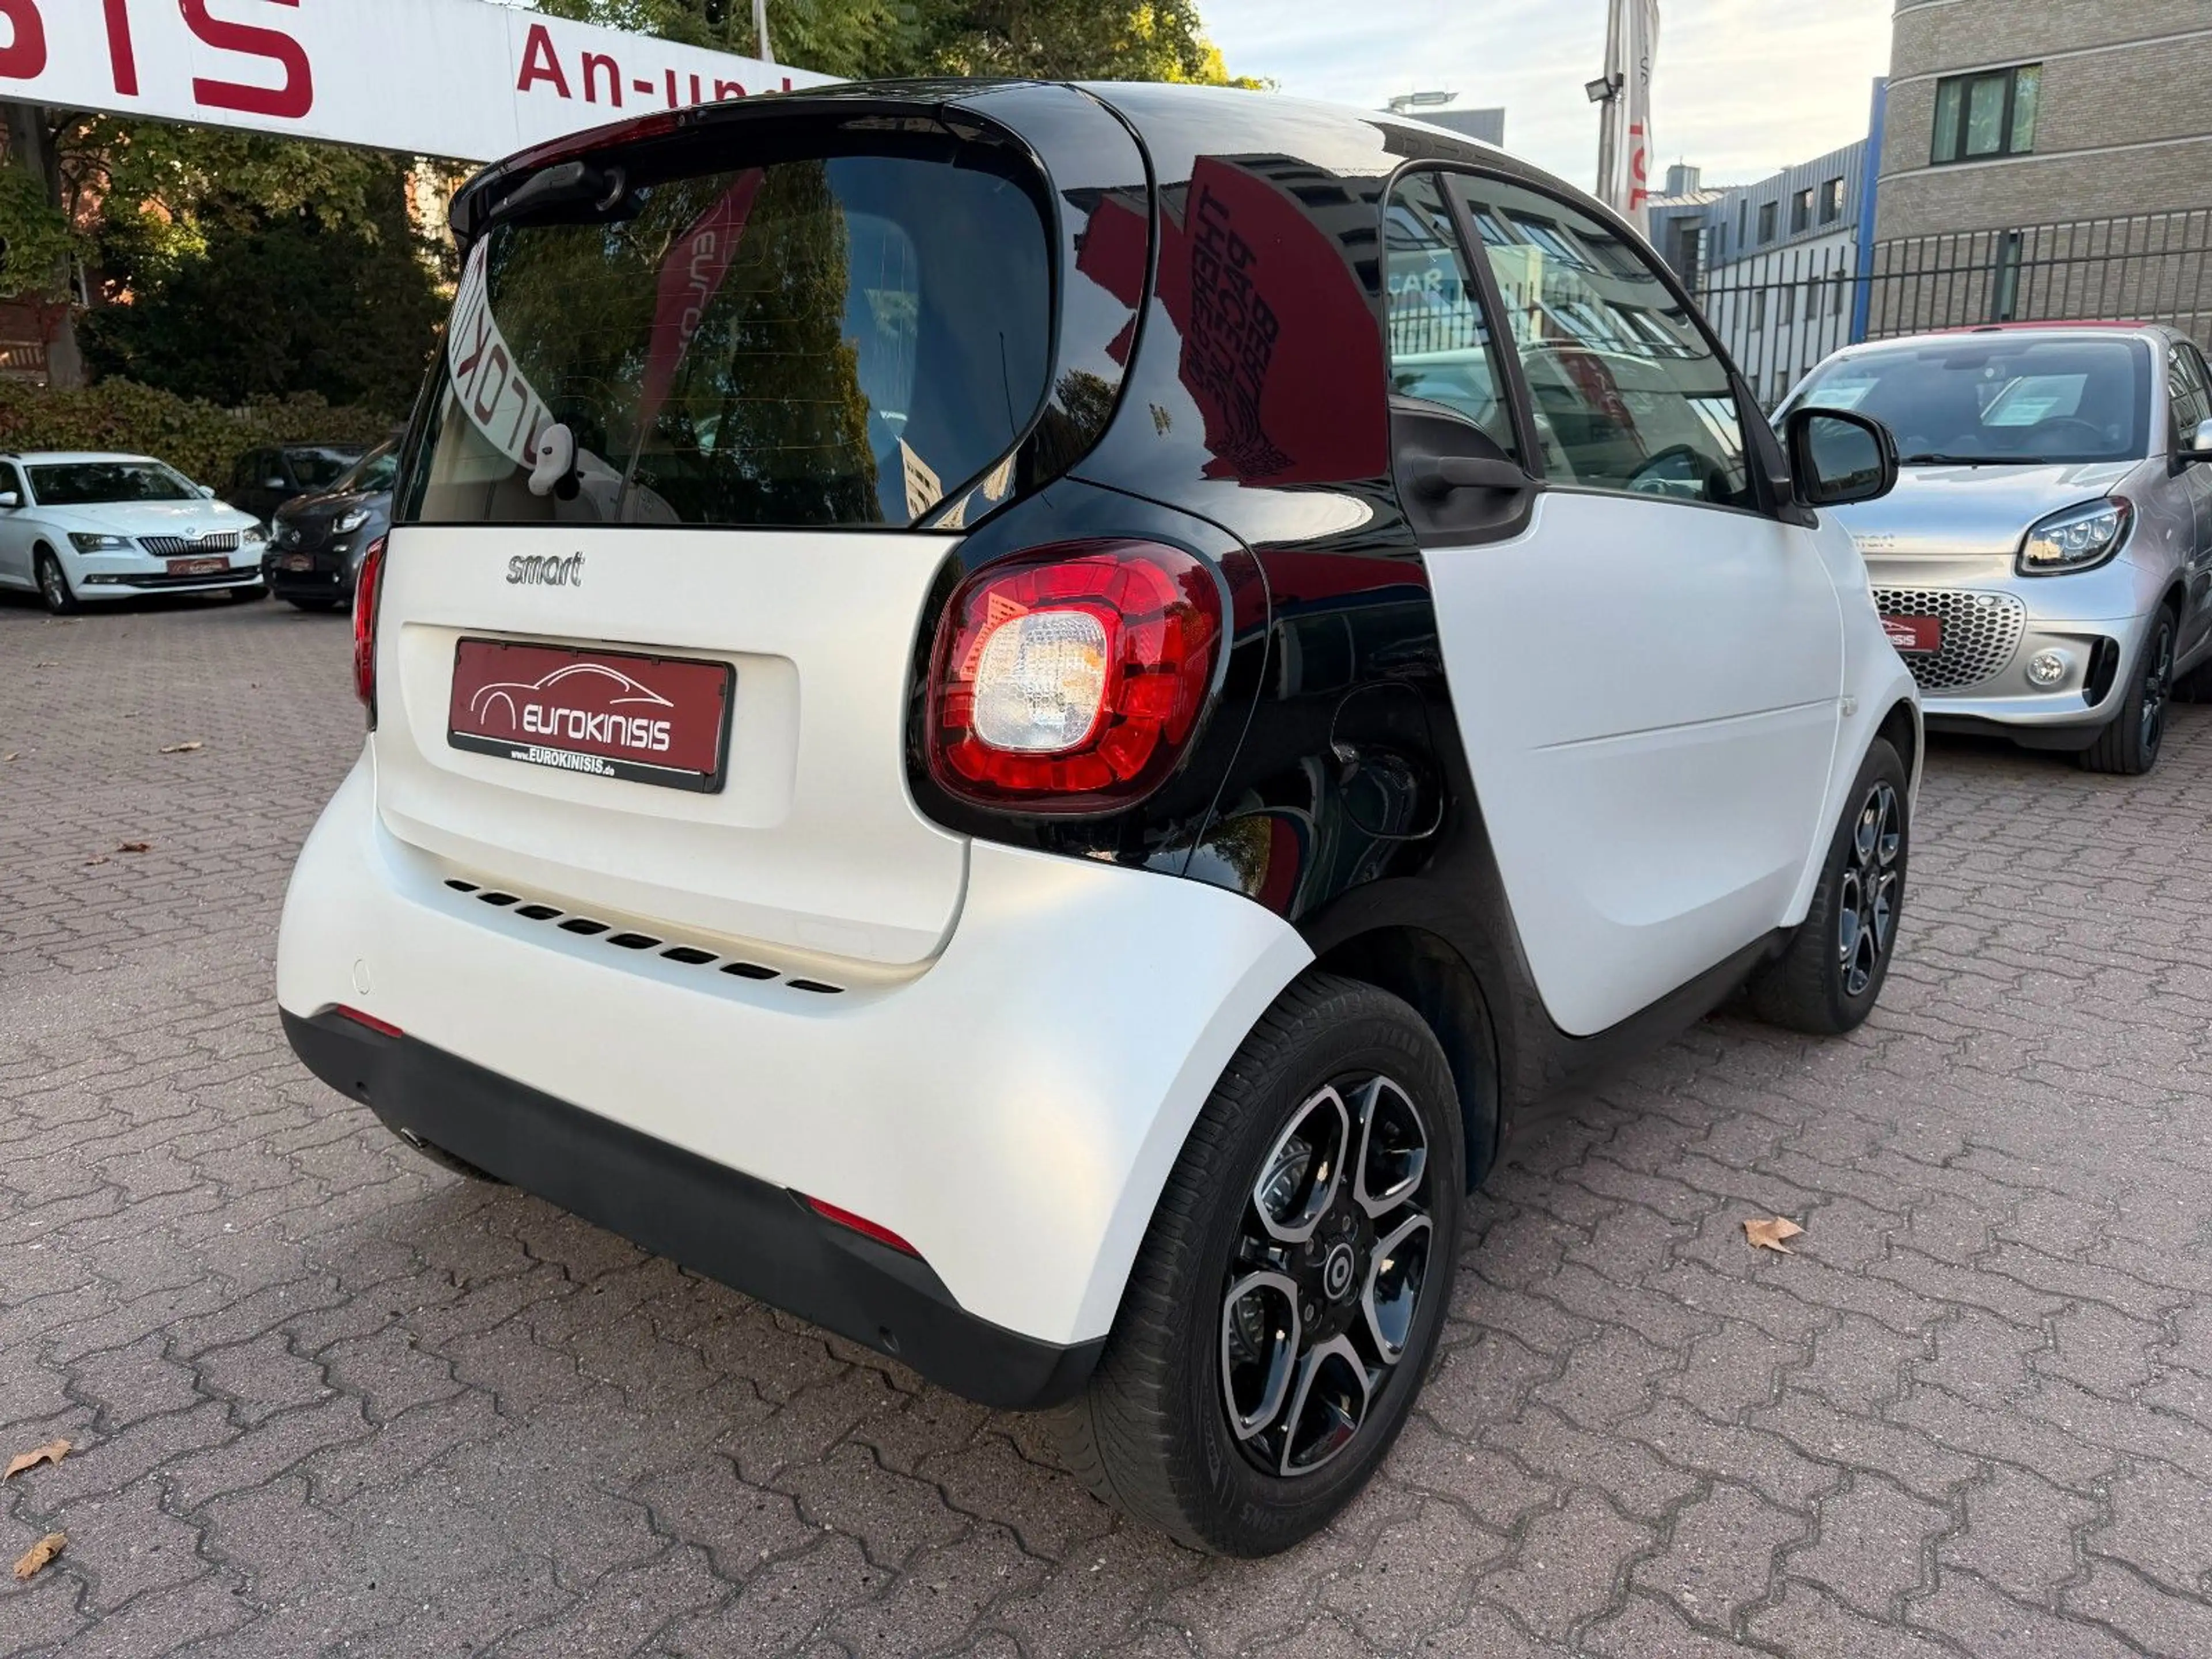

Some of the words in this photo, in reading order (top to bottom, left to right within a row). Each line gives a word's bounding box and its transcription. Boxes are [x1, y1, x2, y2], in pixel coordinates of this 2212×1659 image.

[516, 23, 792, 109] An-un
[506, 551, 586, 588] smart
[511, 747, 615, 777] www.EUROKINISIS.de
